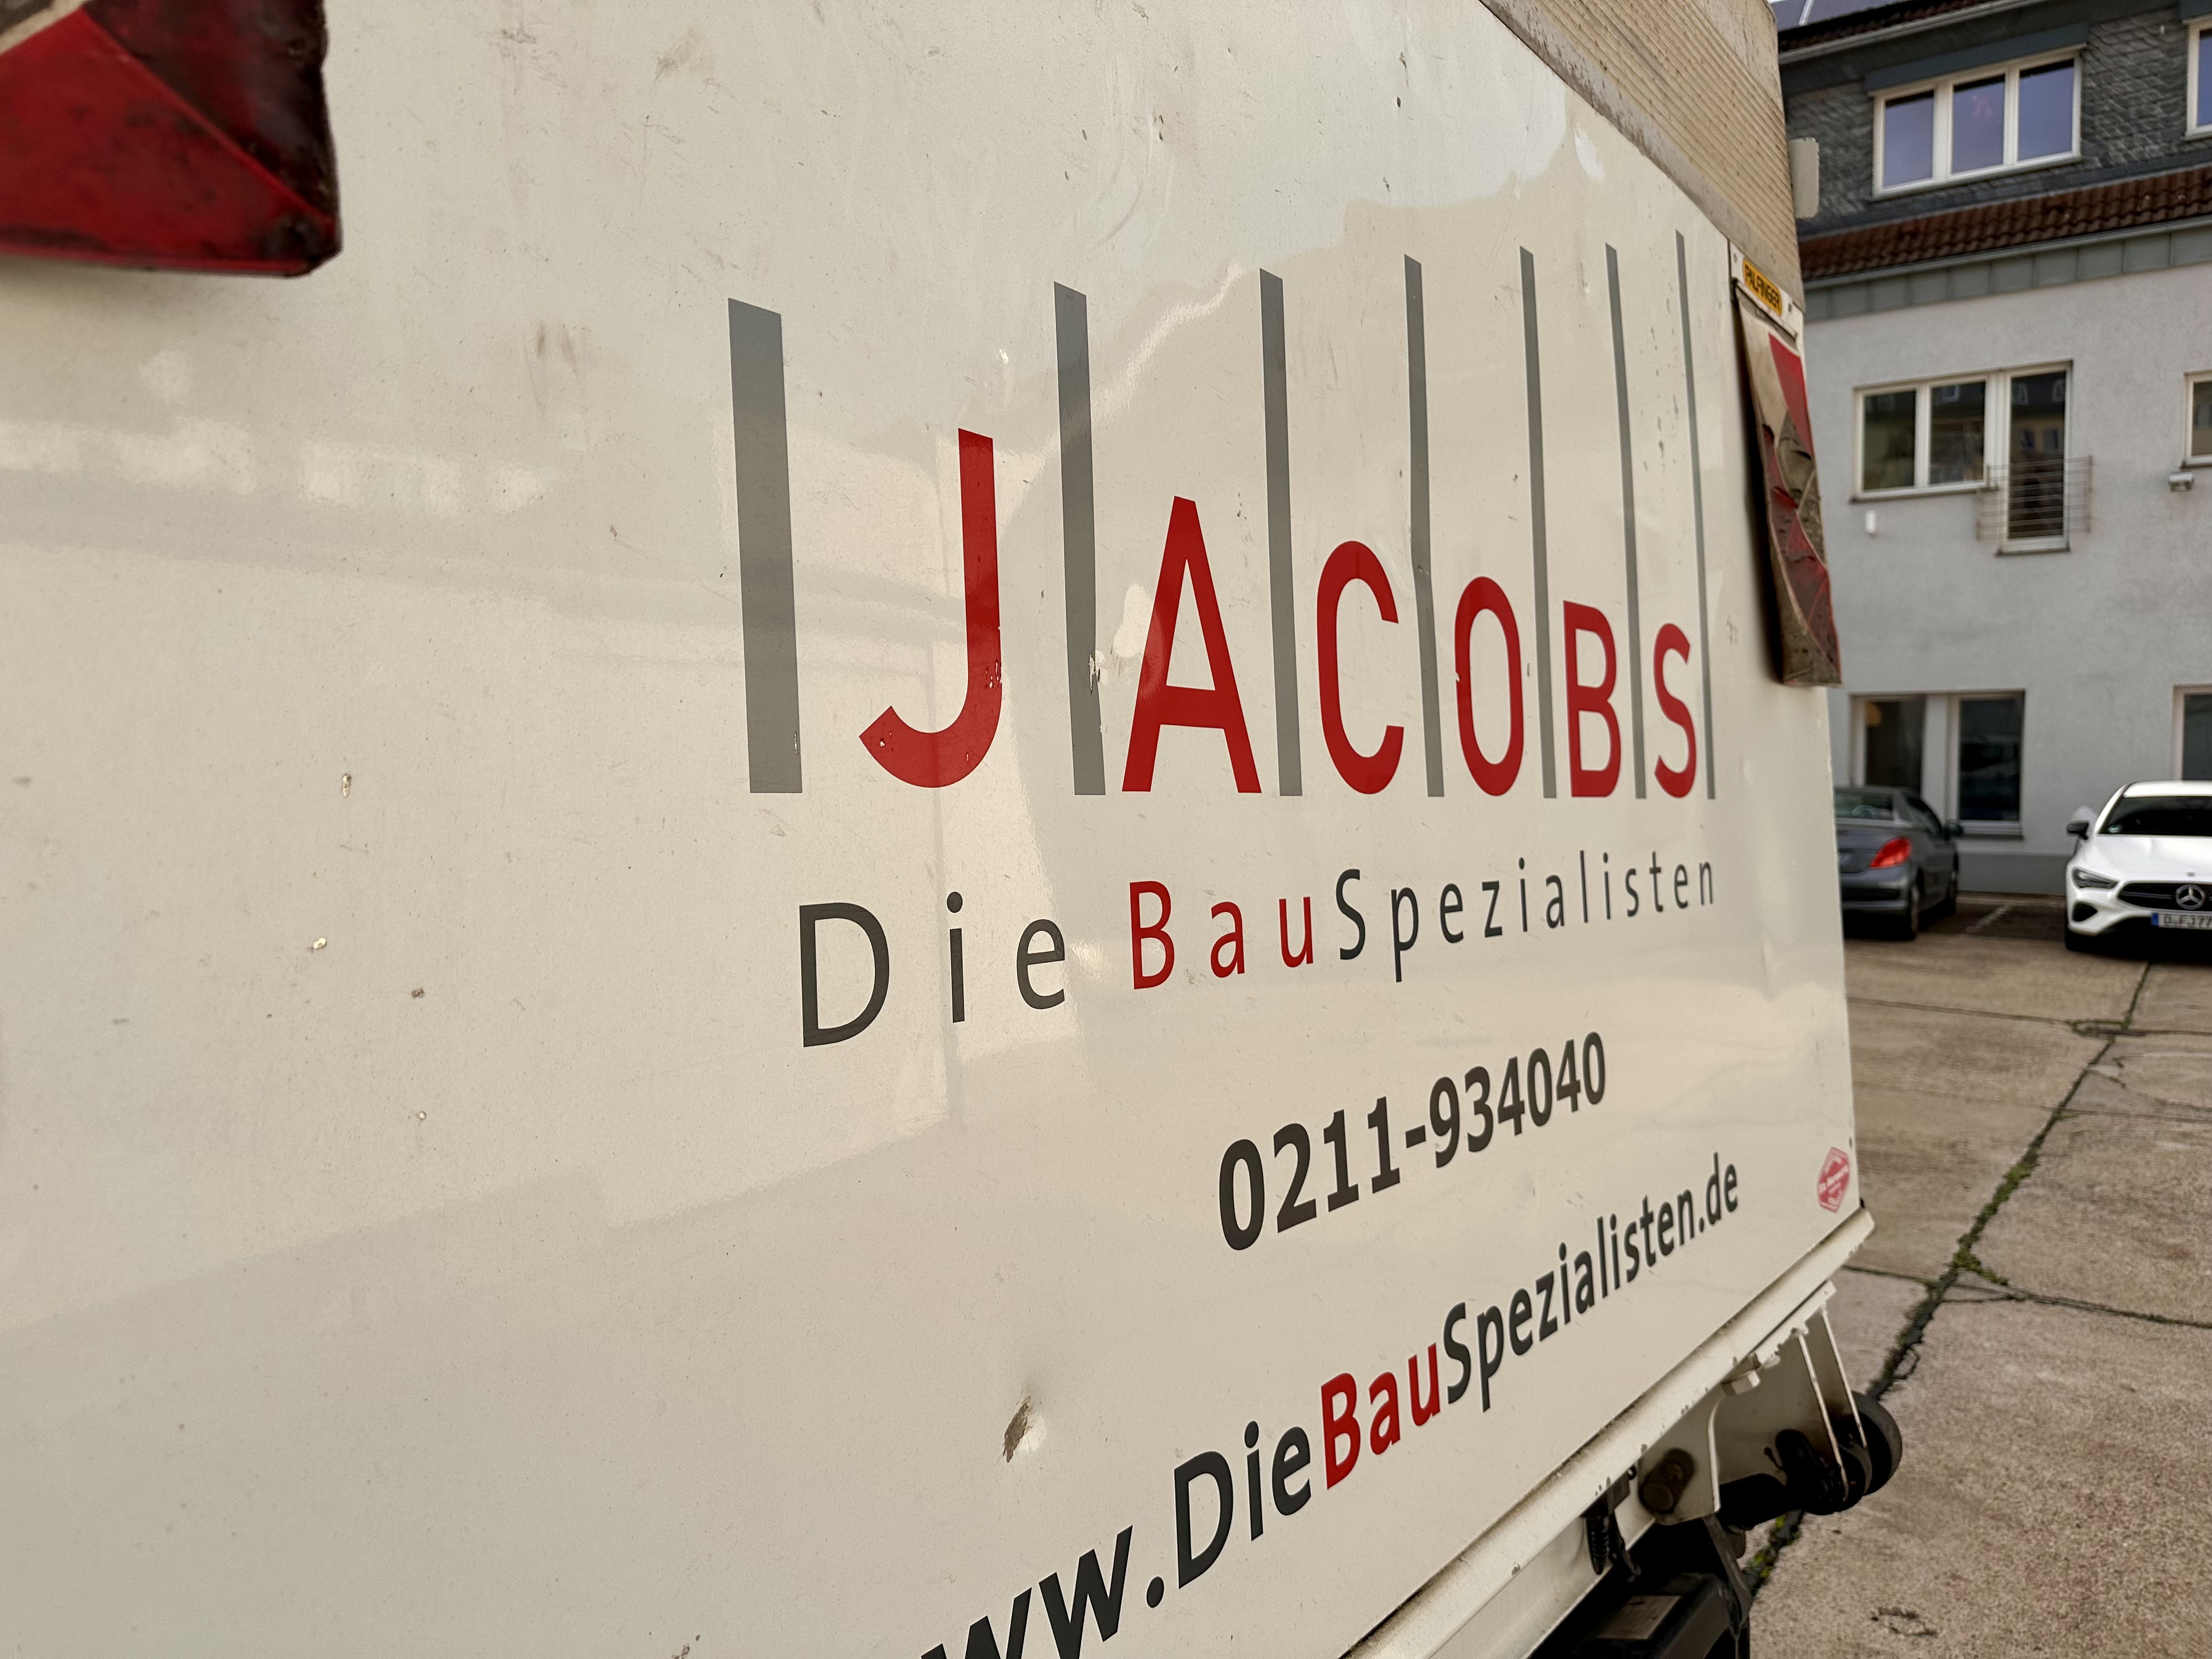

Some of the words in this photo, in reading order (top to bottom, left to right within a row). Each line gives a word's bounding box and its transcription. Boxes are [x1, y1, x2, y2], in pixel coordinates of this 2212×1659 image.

[1744, 263, 1780, 311] PALFINGER
[859, 428, 1696, 798] JACOBS
[799, 891, 1065, 1047] Die
[1129, 850, 1714, 990] BauSpezialisten
[1218, 1031, 1606, 1251] 0211-934040
